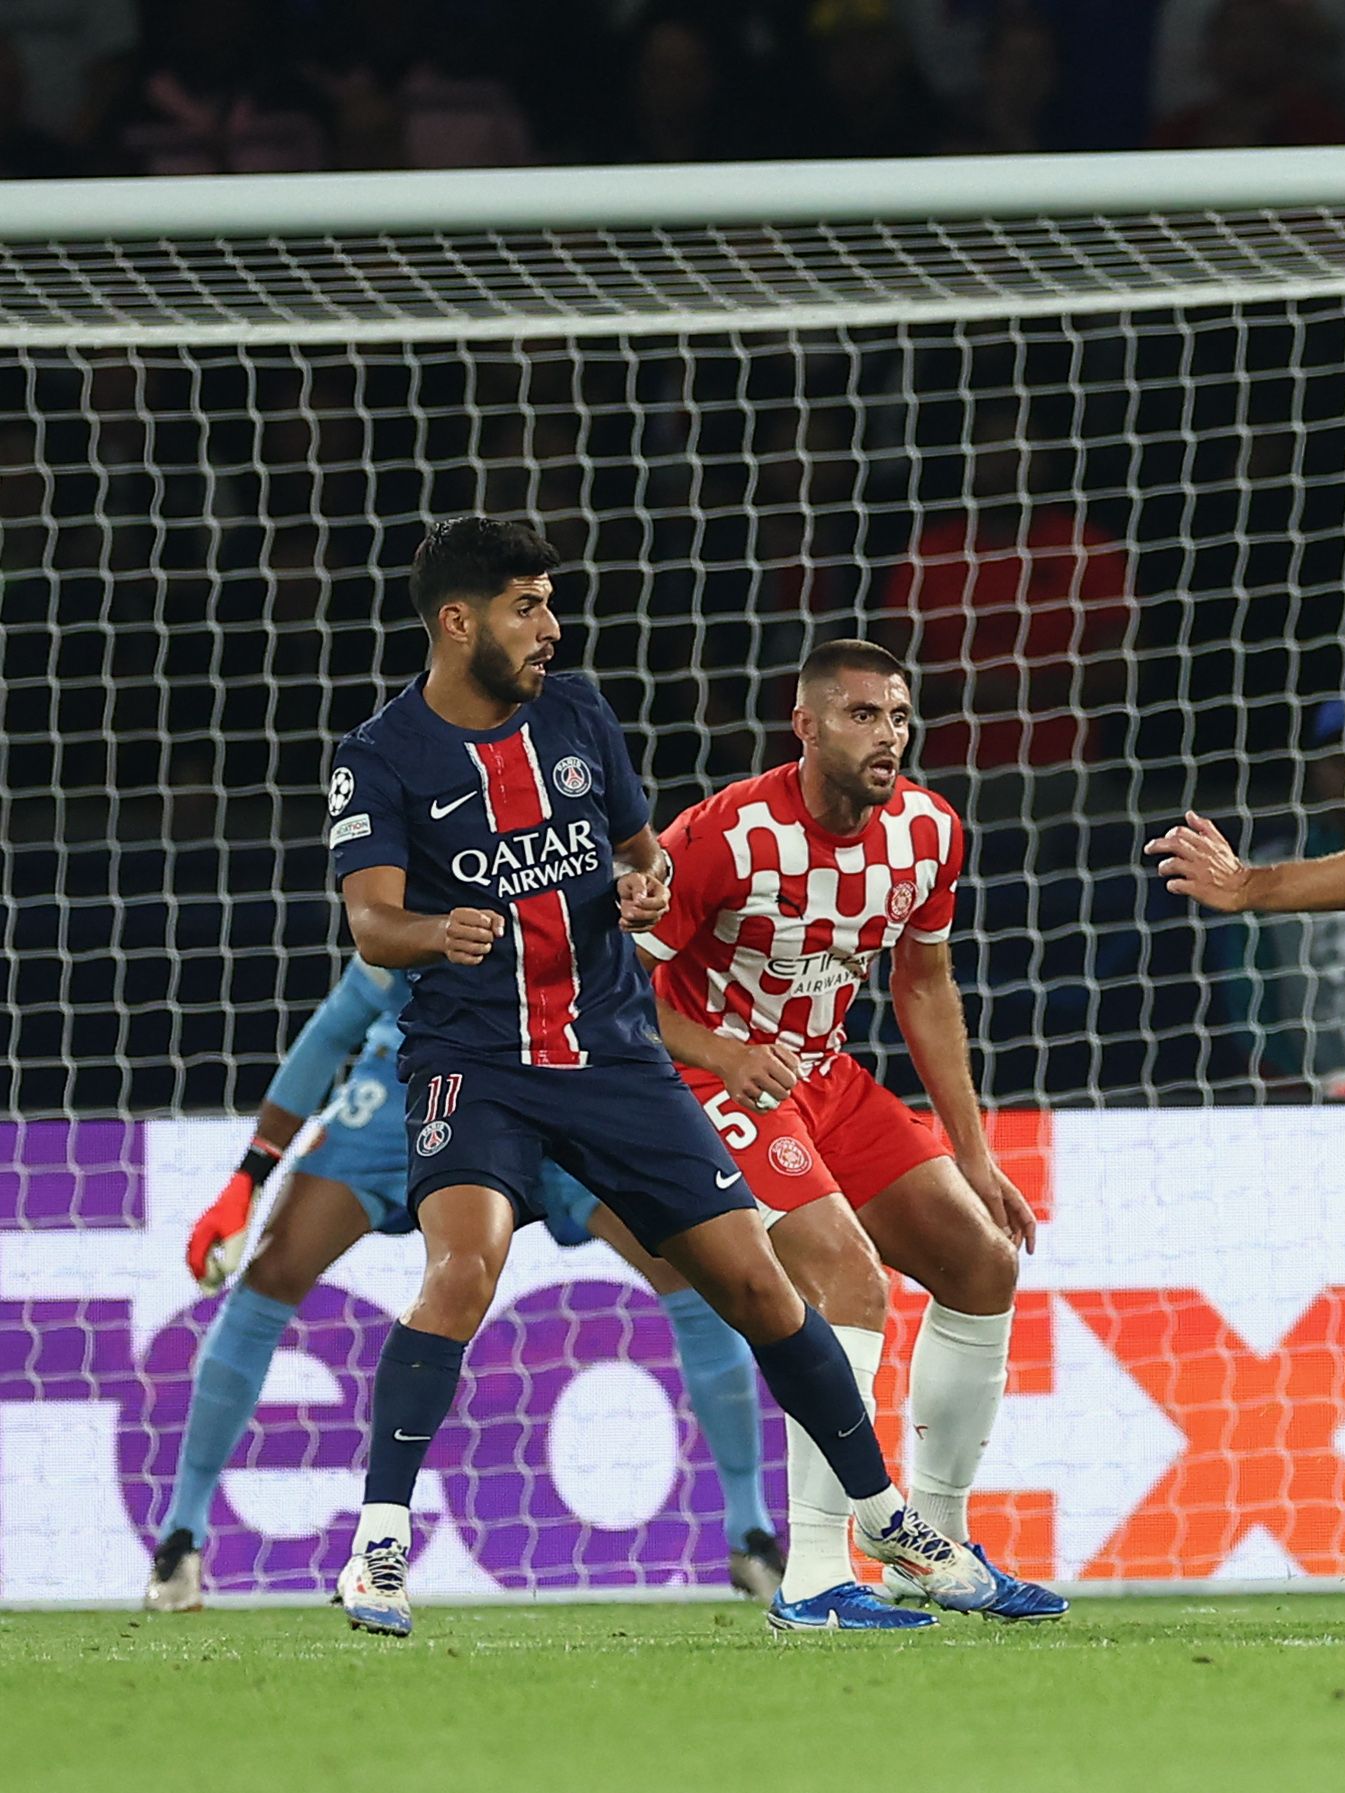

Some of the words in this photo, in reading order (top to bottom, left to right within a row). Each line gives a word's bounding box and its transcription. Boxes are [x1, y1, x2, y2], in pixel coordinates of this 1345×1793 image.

[451, 820, 597, 887] QATAR
[498, 851, 600, 898] AIRWAYS
[423, 1074, 463, 1124] 11
[703, 1090, 758, 1150] 5
